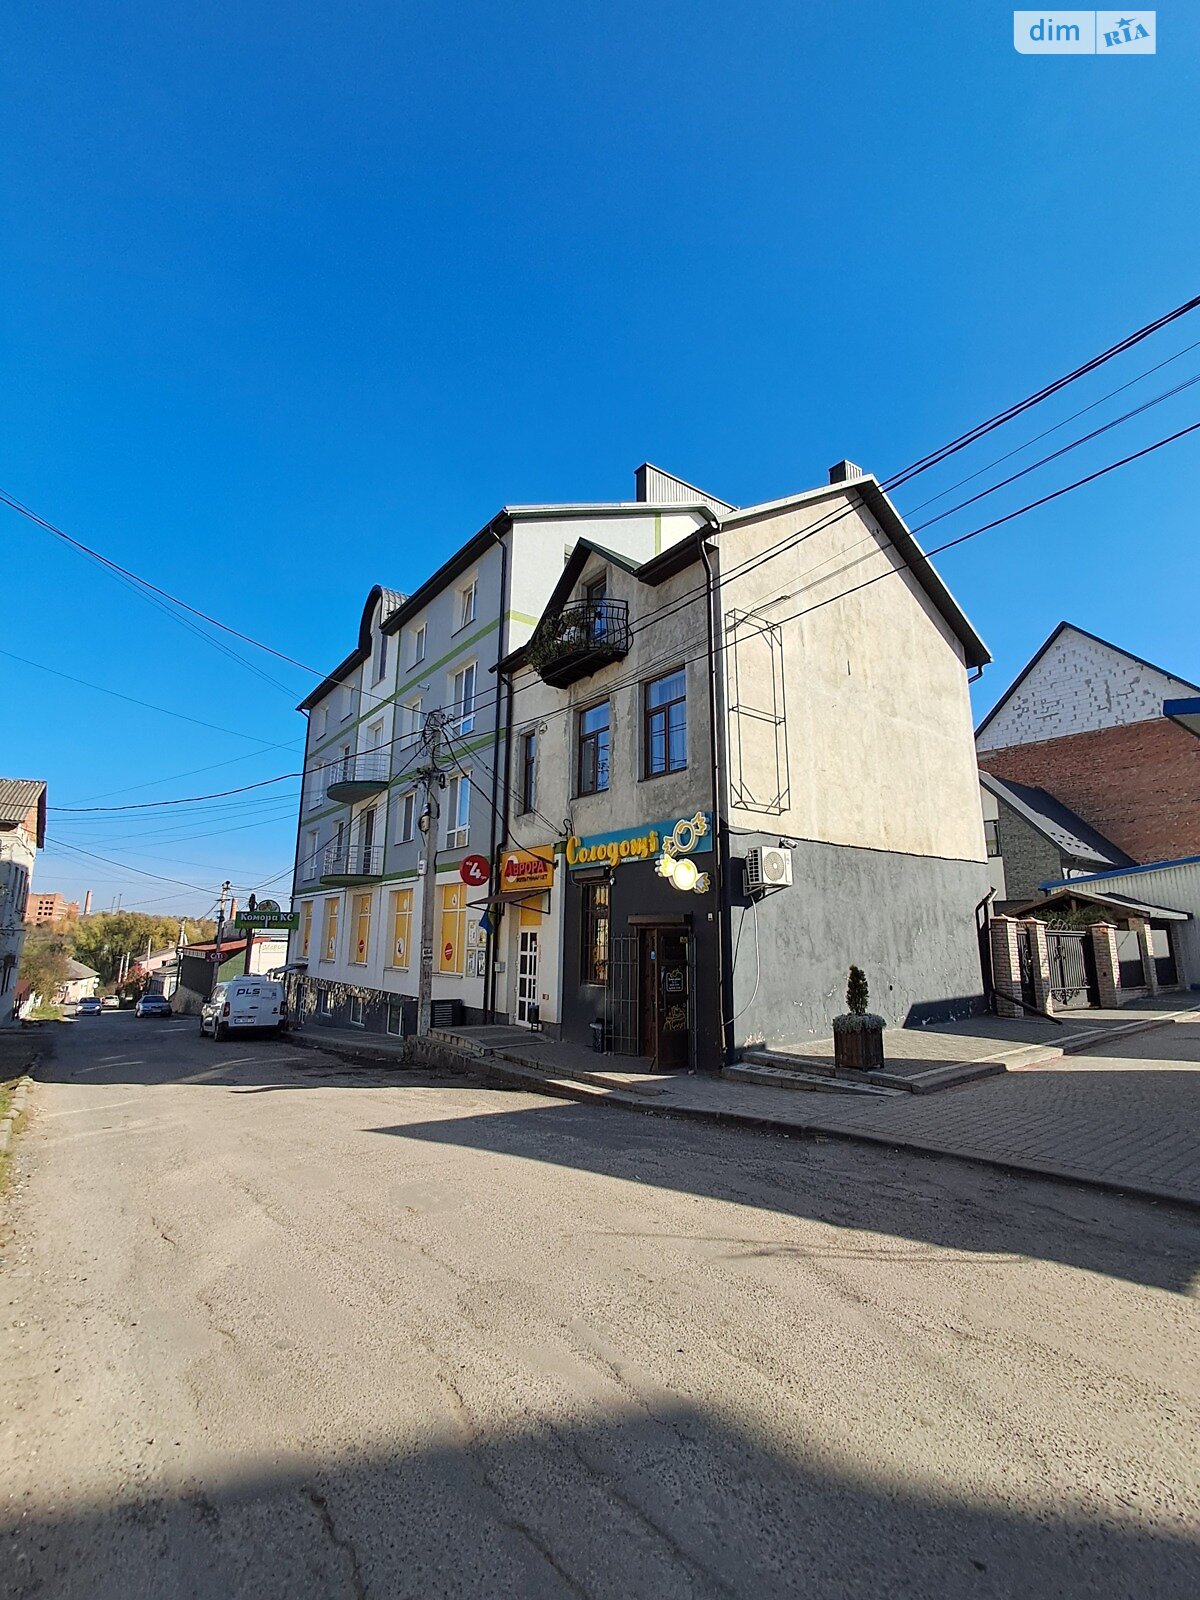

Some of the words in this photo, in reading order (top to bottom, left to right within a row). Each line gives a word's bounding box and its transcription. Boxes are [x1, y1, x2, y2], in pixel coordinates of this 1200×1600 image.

[566, 830, 660, 867] Солодощі
[469, 862, 482, 879] 4
[504, 860, 548, 877] АВРОРА
[240, 912, 278, 928] Комора
[280, 913, 294, 922] КС
